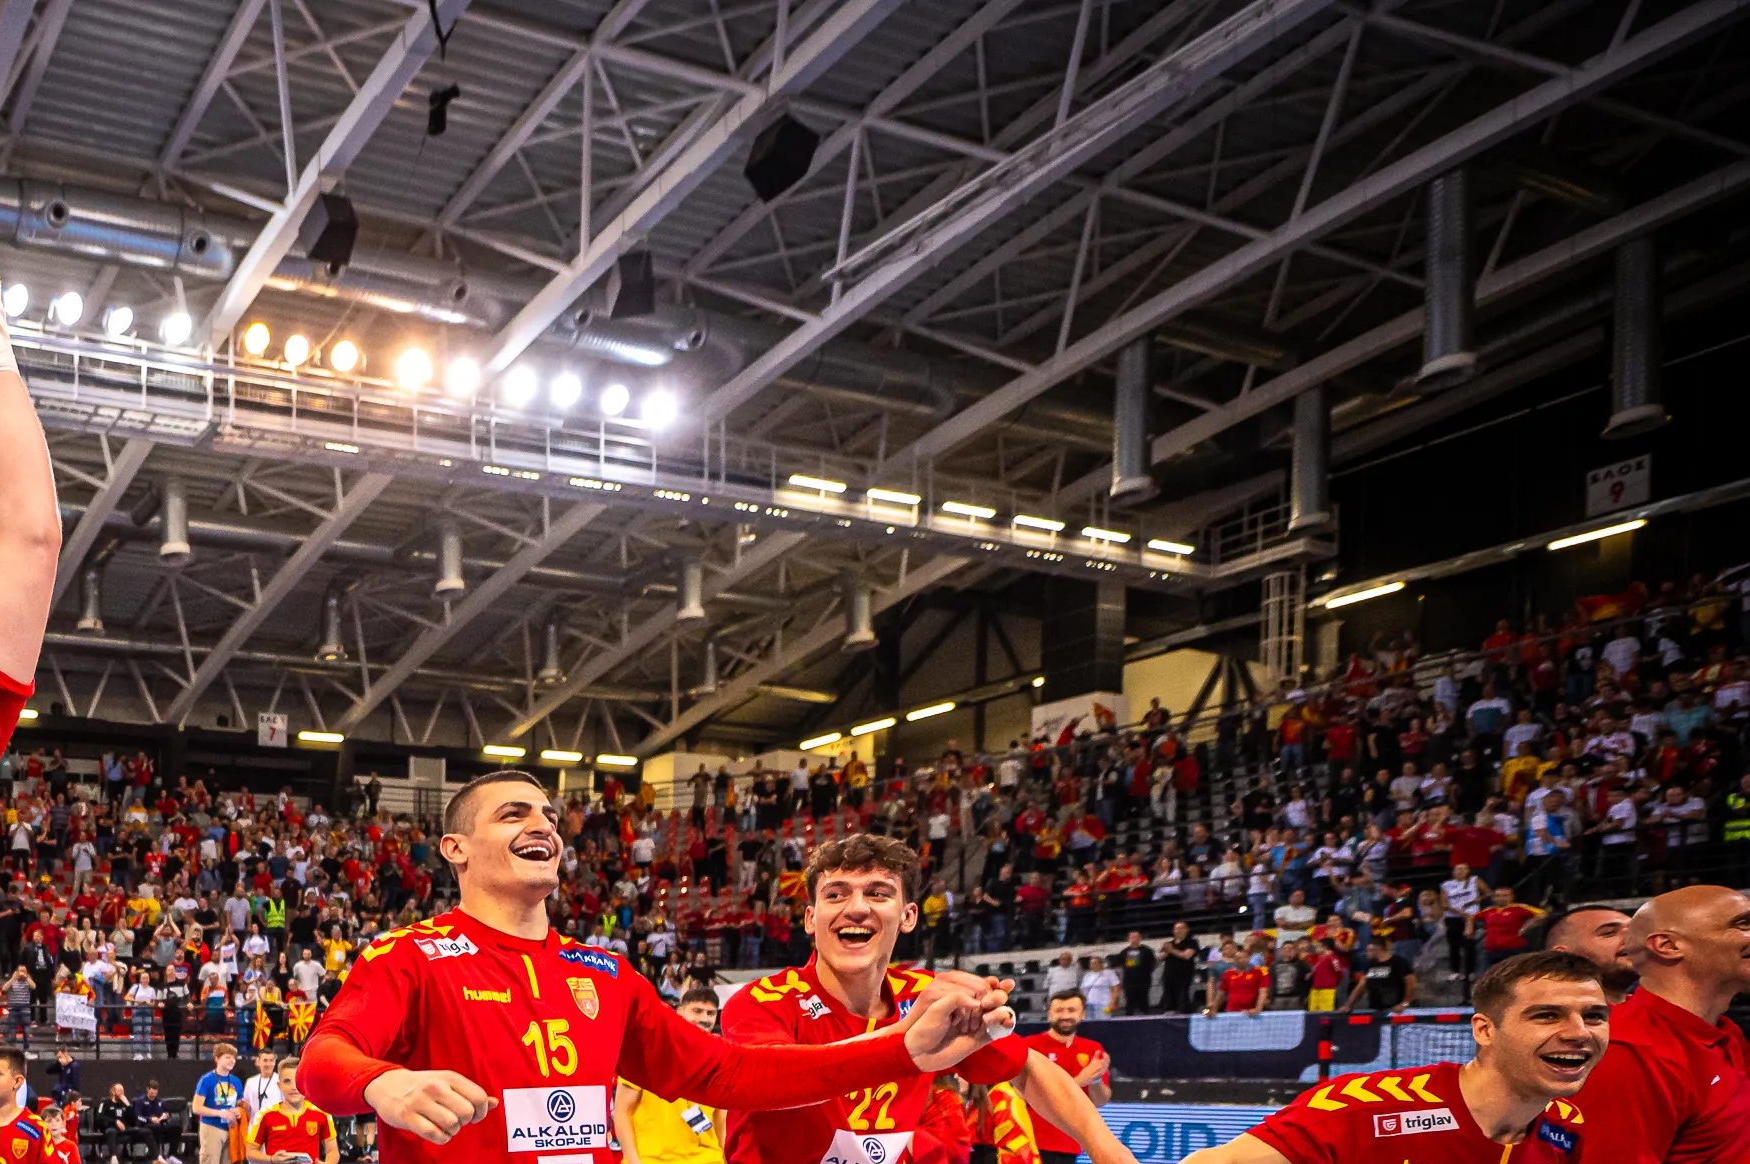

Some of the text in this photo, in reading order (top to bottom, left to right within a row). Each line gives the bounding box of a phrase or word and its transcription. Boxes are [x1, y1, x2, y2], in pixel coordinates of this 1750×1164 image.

[269, 726, 276, 741] 7
[463, 986, 511, 1004] hummel
[522, 1018, 578, 1078] 15
[844, 1081, 898, 1131] 22
[512, 1123, 606, 1139] ALKALOID
[1405, 1113, 1452, 1131] triglav
[535, 1137, 591, 1148] SKOPJE
